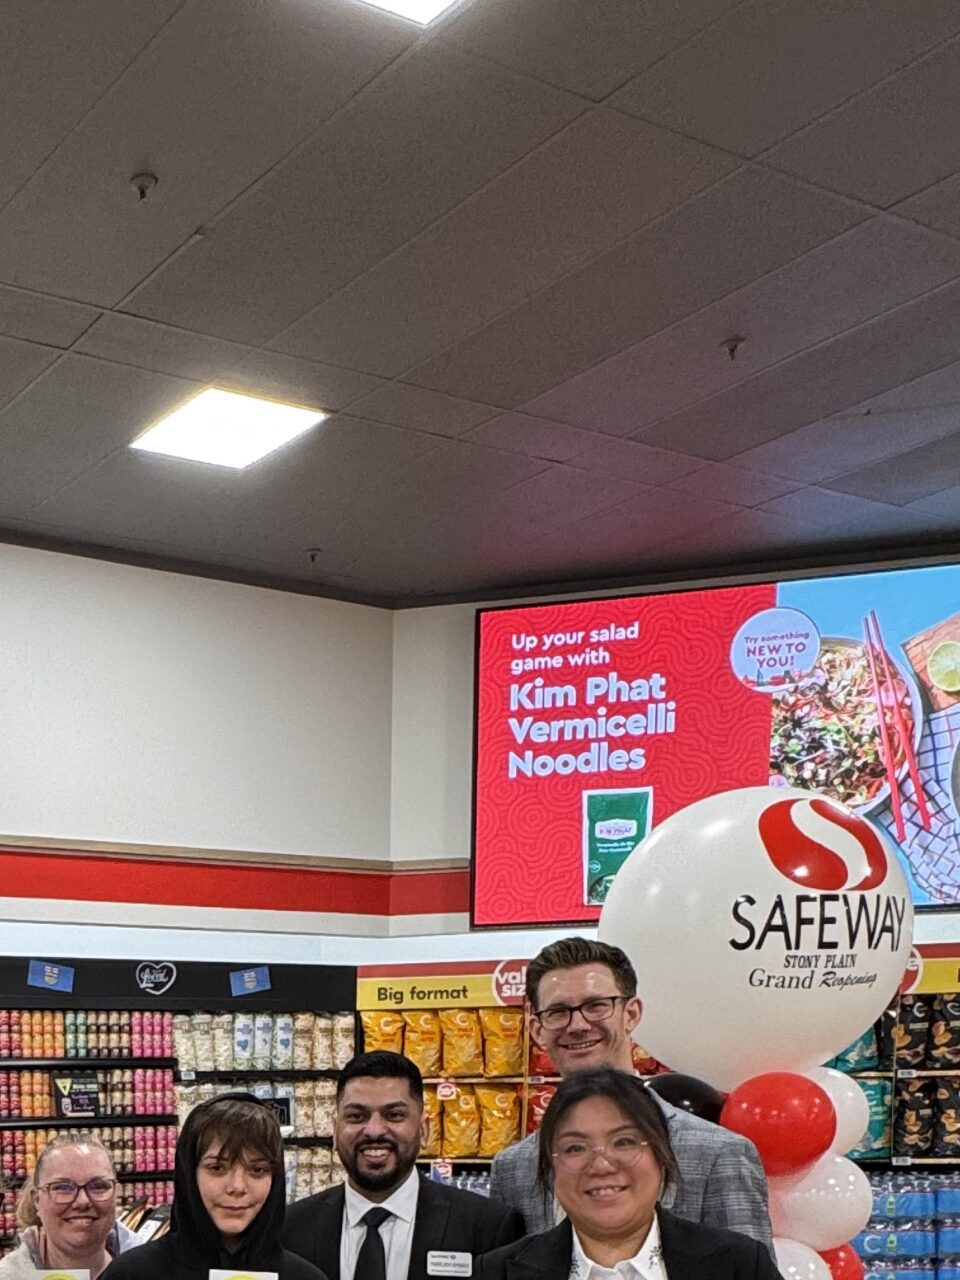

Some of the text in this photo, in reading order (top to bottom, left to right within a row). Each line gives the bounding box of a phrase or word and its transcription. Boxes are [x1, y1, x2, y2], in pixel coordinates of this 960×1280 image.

[512, 621, 639, 652] Up your salad
[744, 632, 810, 645] Try something
[747, 642, 806, 657] NEW TO
[511, 647, 610, 675] game with
[757, 656, 794, 668] YOU!
[509, 672, 666, 711] Kim Phat
[508, 701, 677, 745] Vermicelli
[508, 742, 646, 779] Noodles
[728, 894, 906, 952] SAFEWAY
[784, 953, 858, 969] STONY PLAIN
[497, 966, 527, 985] val
[749, 968, 878, 991] Grand Reopening
[377, 985, 469, 1004] Big format
[501, 984, 527, 997] siz
